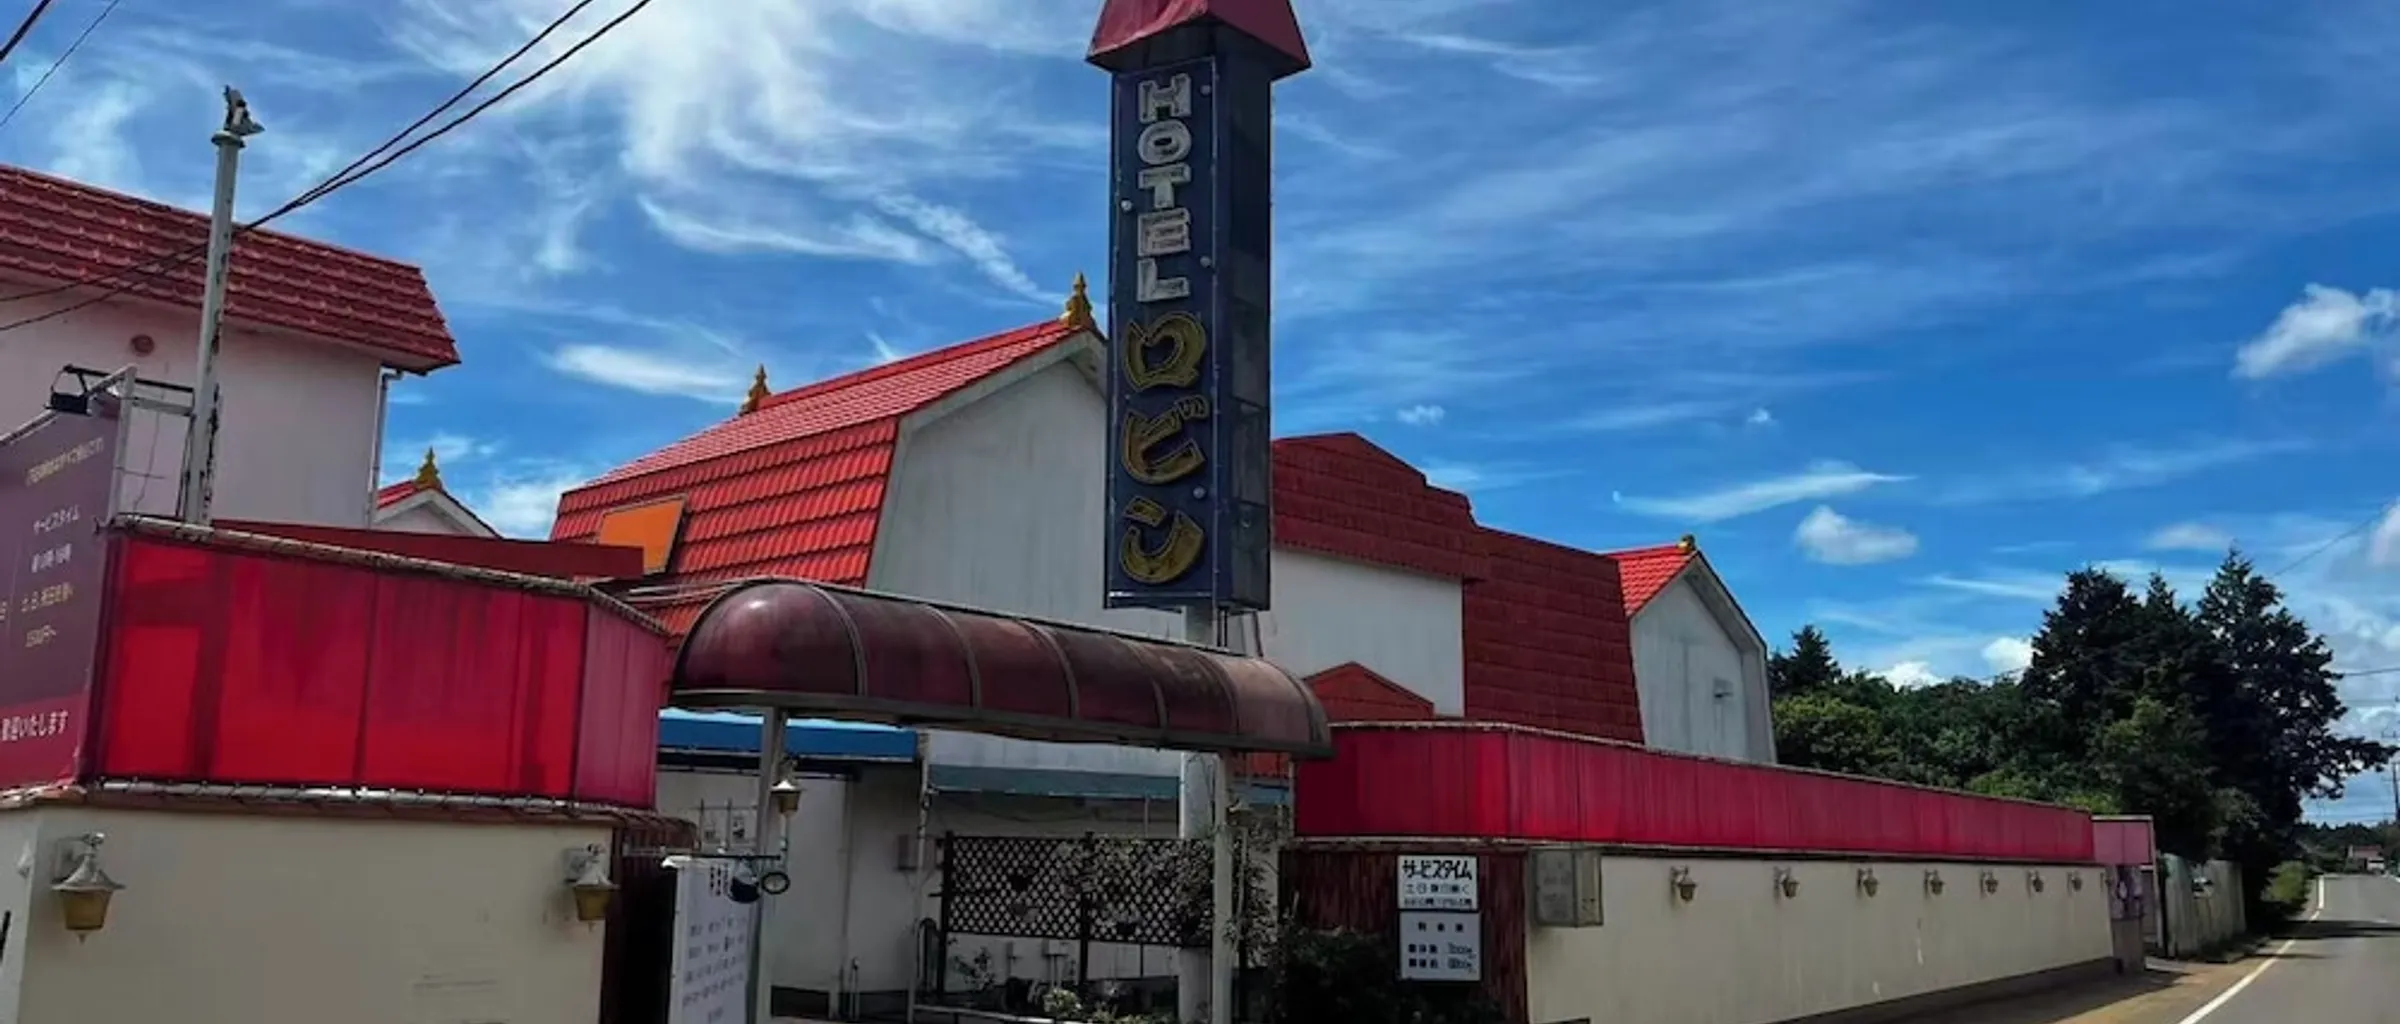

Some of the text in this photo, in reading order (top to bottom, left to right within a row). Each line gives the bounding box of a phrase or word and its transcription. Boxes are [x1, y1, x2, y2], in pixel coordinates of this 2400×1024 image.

[1137, 73, 1191, 302] HOTEL
[1119, 311, 1207, 584] ロビン
[1402, 859, 1473, 880] サービスタイム
